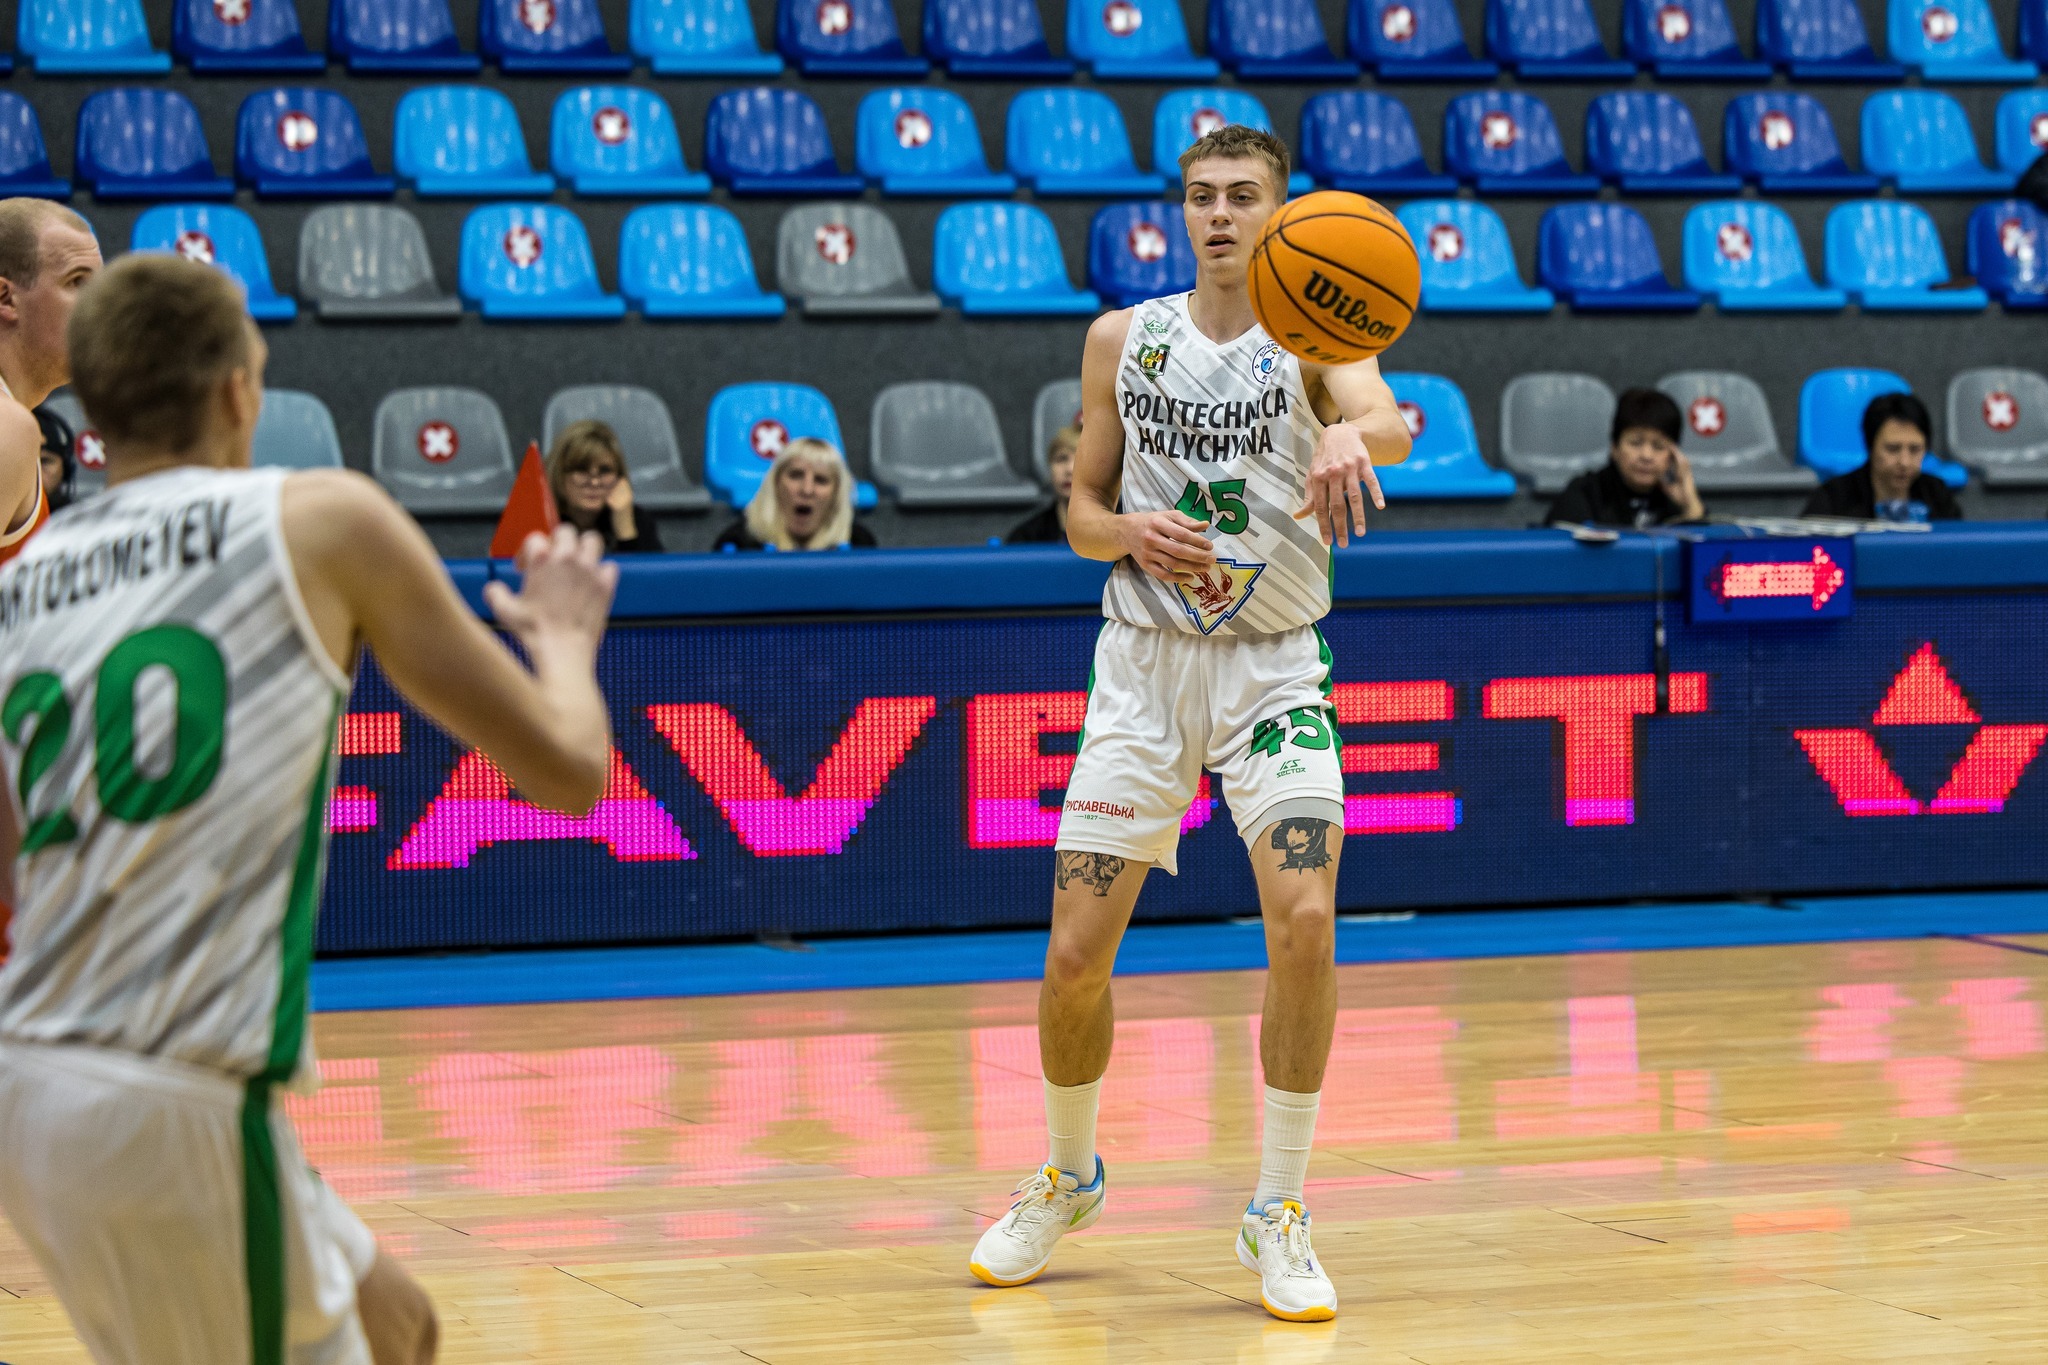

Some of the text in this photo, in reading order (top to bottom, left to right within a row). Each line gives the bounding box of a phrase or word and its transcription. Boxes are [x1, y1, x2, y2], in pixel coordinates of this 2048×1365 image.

[1304, 270, 1396, 341] Wilson
[1124, 387, 1288, 428] POLYTECHNCA
[1138, 425, 1274, 462] HALYCHYNA
[1175, 479, 1249, 535] 45
[2, 624, 229, 857] 20
[1244, 706, 1330, 762] 45
[1064, 800, 1135, 820] РУСКАВЕЦЬКА
